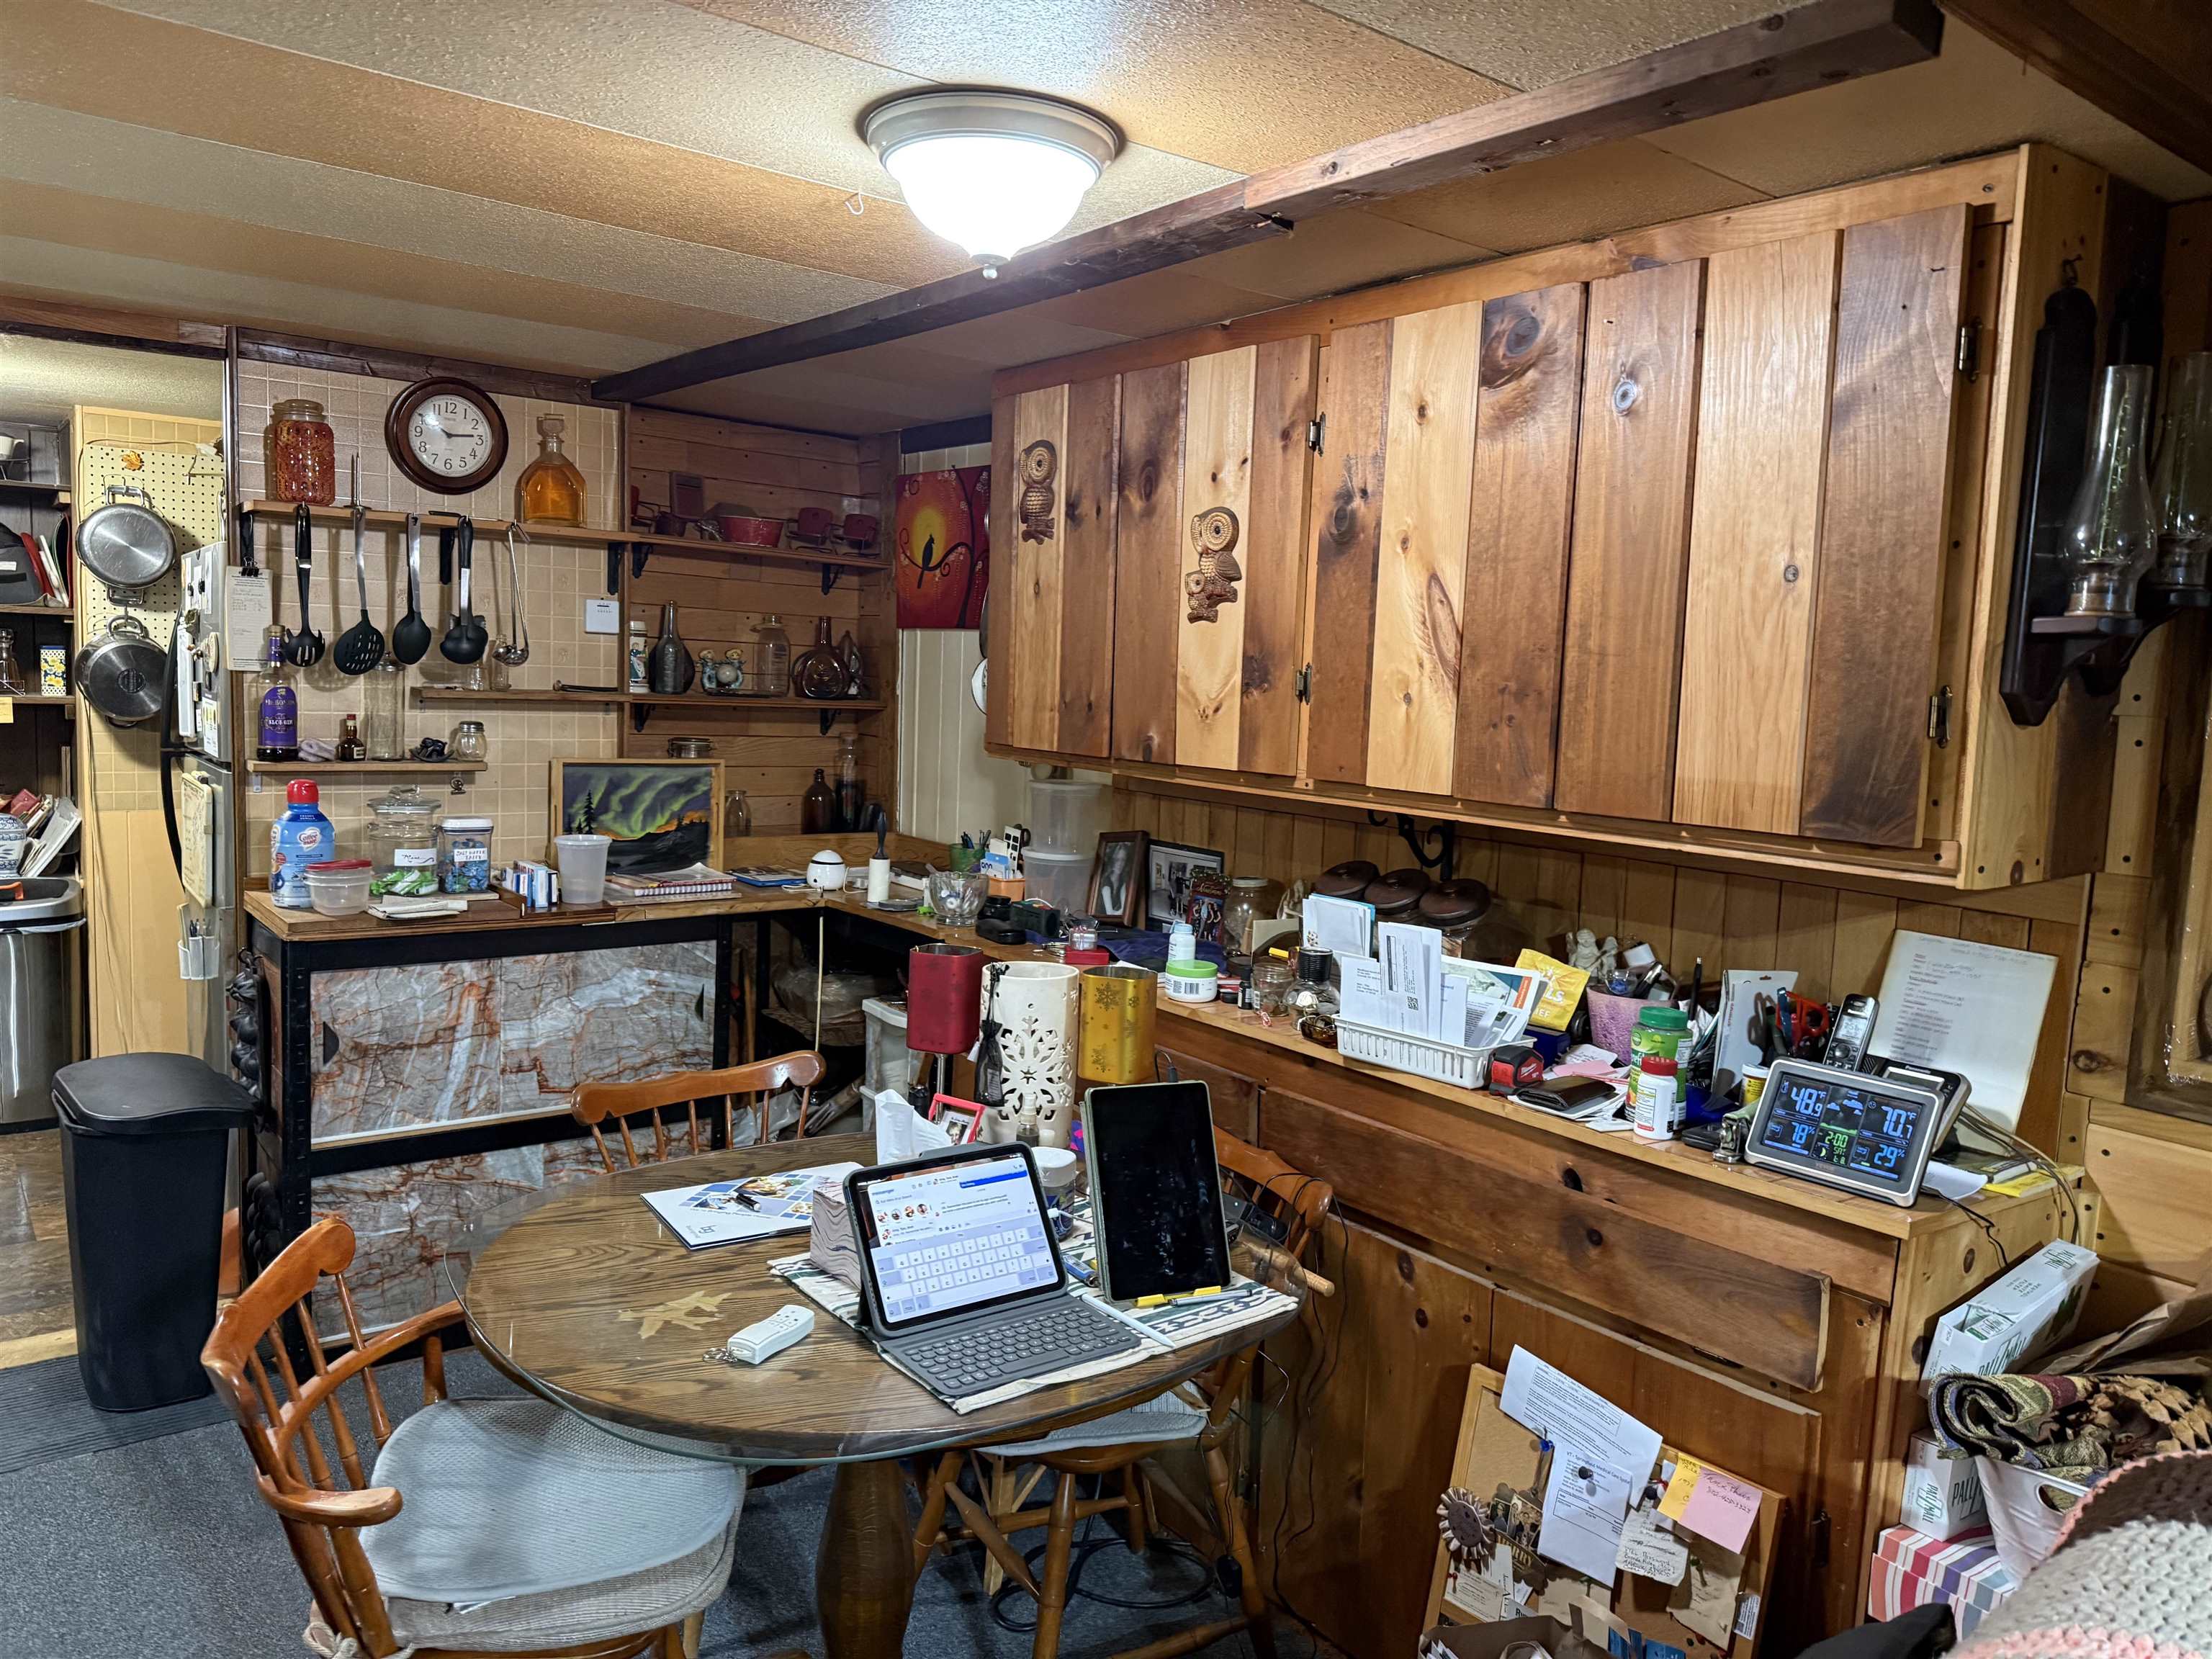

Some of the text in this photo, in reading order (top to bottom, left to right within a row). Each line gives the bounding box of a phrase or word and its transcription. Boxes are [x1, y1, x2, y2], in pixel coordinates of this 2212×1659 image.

[433, 404, 441, 415] 11
[445, 402, 457, 414] 12
[464, 408, 467, 419] 1
[471, 418, 479, 430] 2
[414, 426, 423, 437] 9
[475, 434, 484, 446] 3
[418, 441, 427, 453] 8
[431, 453, 439, 464] 7
[469, 448, 478, 459] 4
[444, 458, 452, 470] 6
[459, 457, 467, 468] 5
